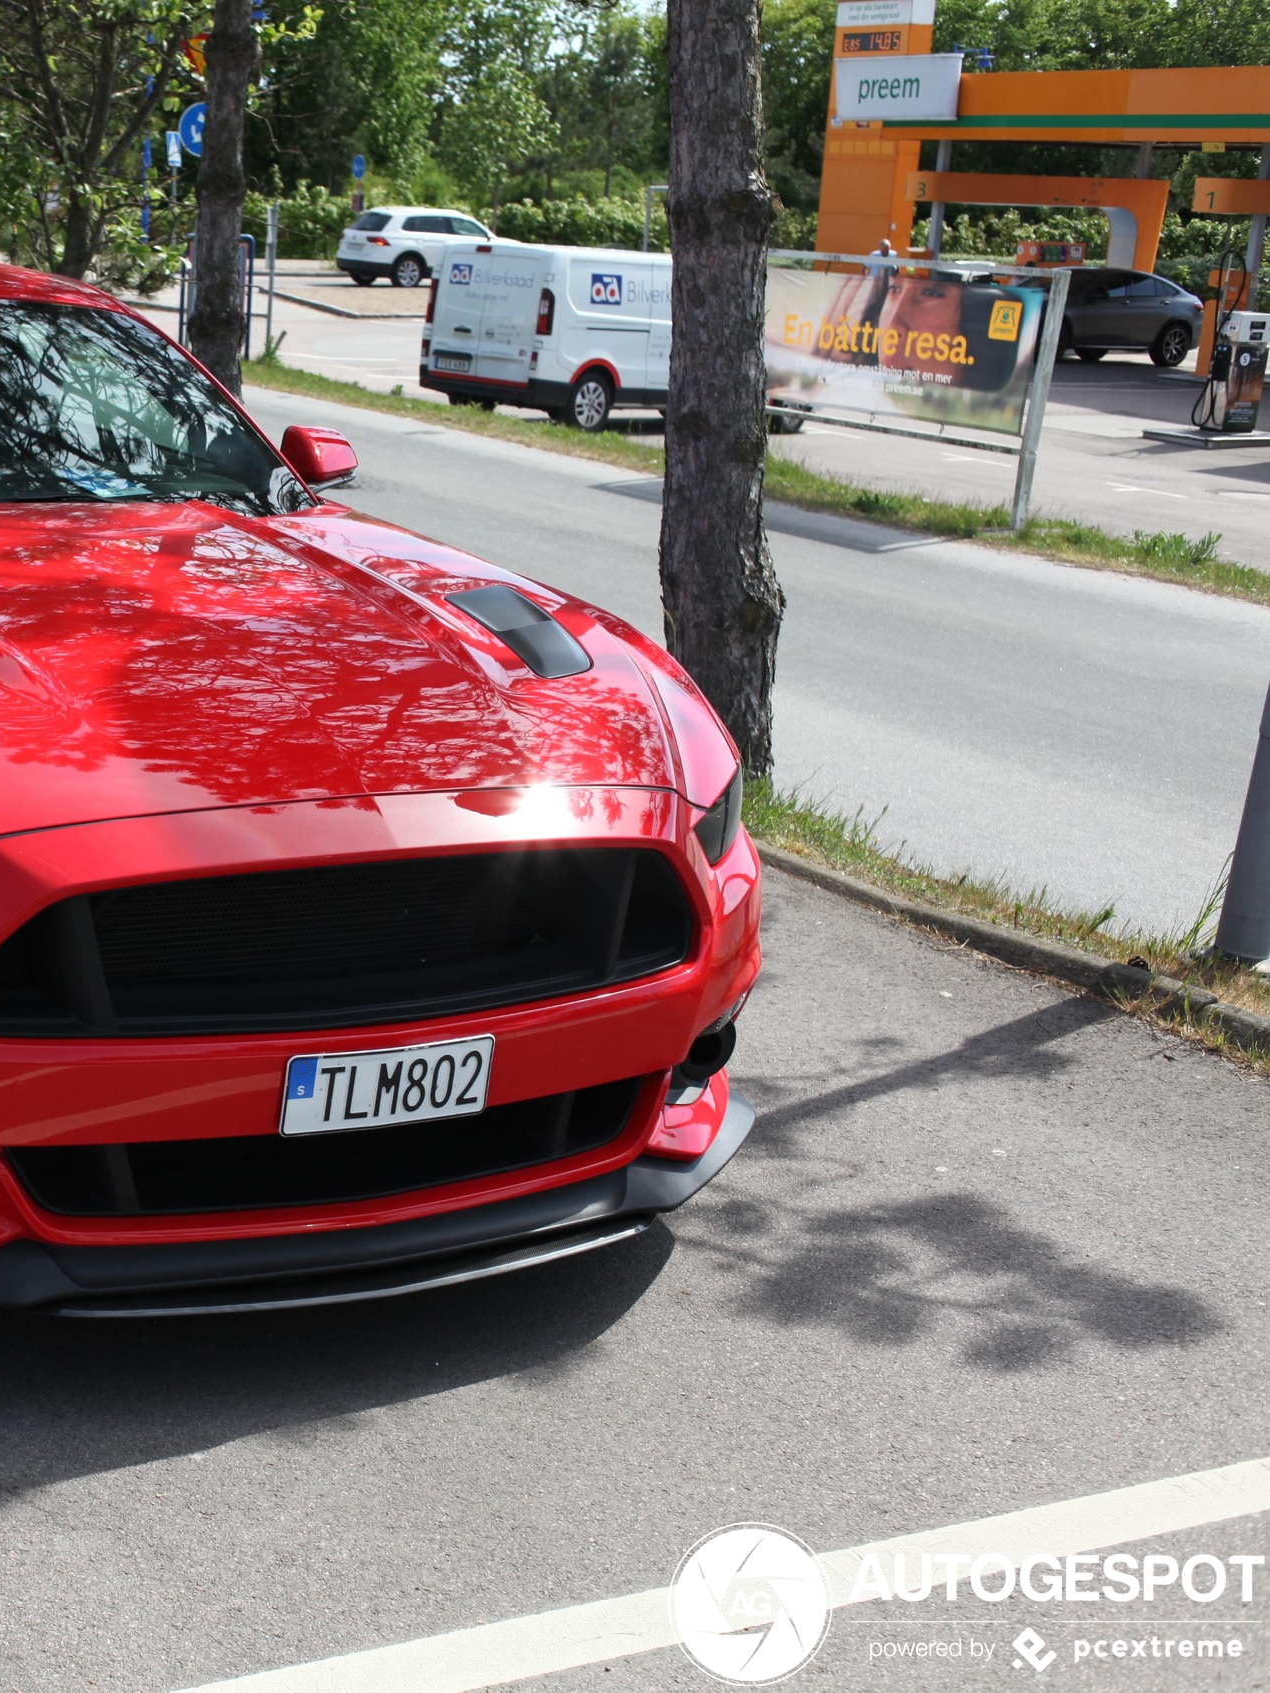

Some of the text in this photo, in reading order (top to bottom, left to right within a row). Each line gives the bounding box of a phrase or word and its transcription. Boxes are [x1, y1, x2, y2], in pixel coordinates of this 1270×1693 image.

[874, 2, 898, 11] bankkort
[844, 39, 861, 51] E85
[858, 77, 920, 104] preem
[916, 181, 927, 199] 3
[1205, 190, 1217, 210] 1
[474, 268, 536, 289] Bilverkstad
[783, 314, 975, 366] En bättre resa.
[993, 327, 1013, 336] preem
[858, 363, 902, 379] omställning
[903, 369, 920, 380] mot
[922, 372, 933, 382] en
[935, 373, 952, 384] mer
[885, 383, 924, 397] preem.se
[296, 1049, 483, 1122] S TLM802
